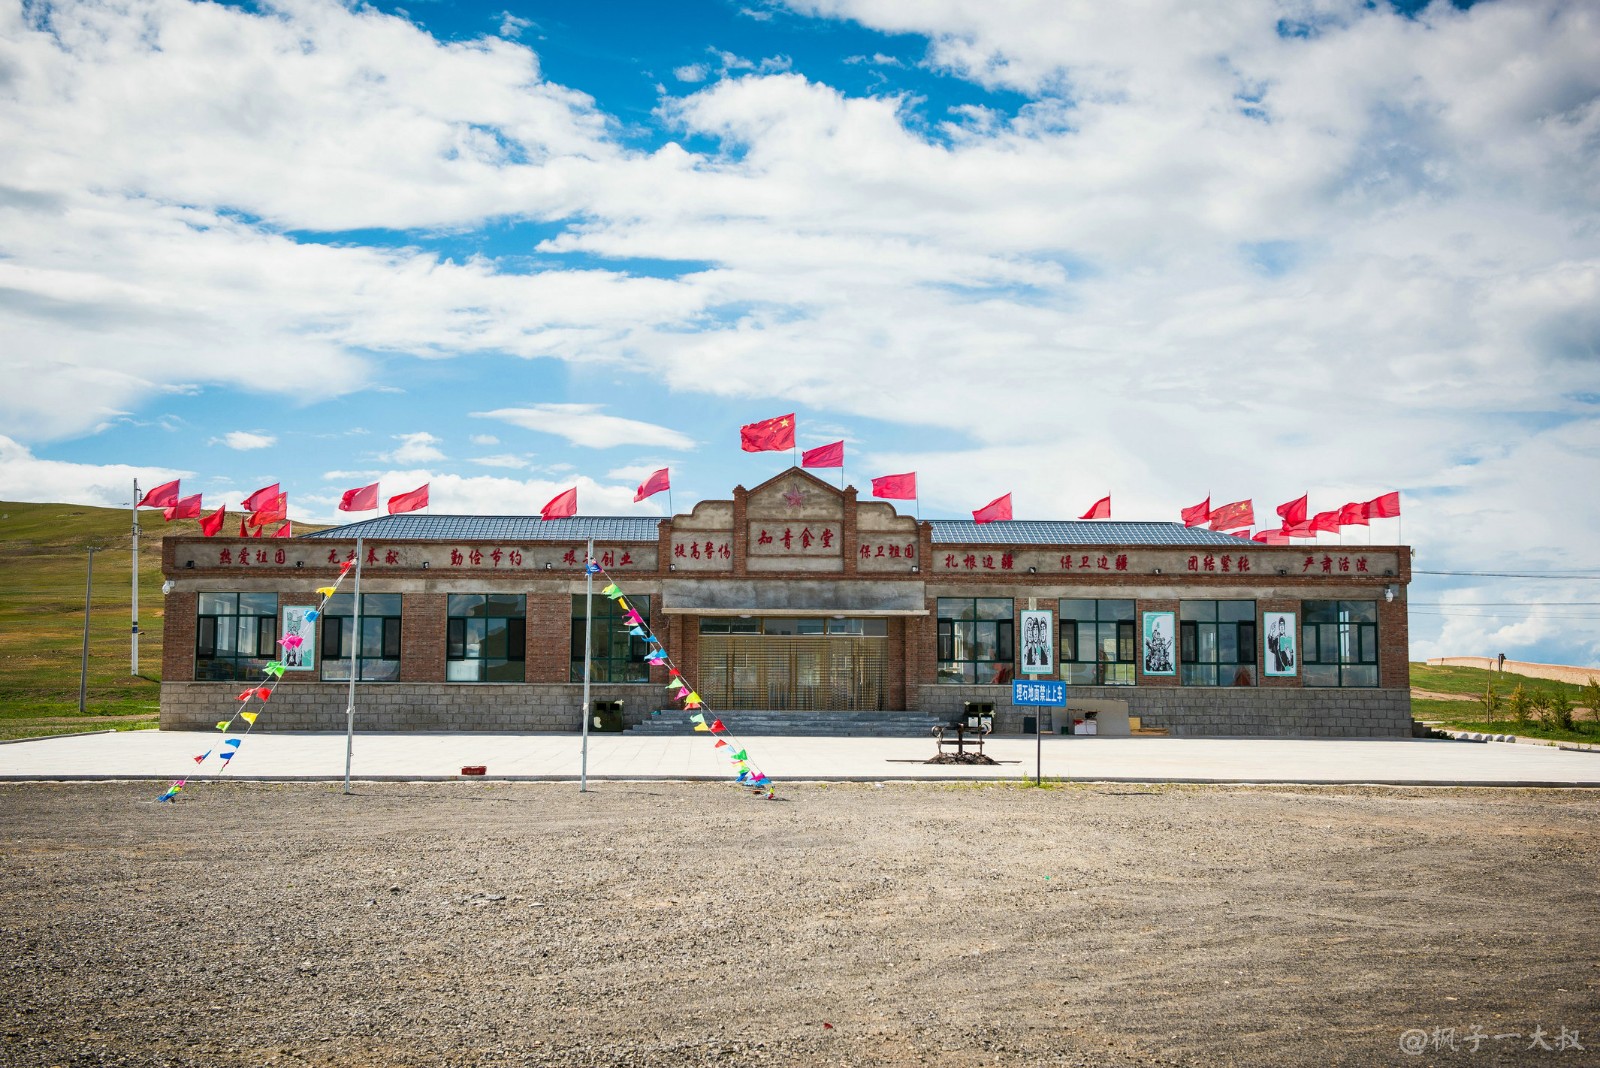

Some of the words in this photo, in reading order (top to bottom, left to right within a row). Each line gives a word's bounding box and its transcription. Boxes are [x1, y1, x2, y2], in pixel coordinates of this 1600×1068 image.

[758, 527, 834, 549] 知青食堂
[219, 547, 286, 566] 热爱祖国
[450, 547, 522, 567] 勤俭节约
[563, 549, 633, 567] 艰创业
[674, 541, 731, 560] 提高警惕
[860, 544, 915, 559] 保卫祖国
[945, 553, 1015, 570] 扎根边疆
[1060, 554, 1129, 571] 保卫边疆
[1187, 554, 1251, 573] 团结紧张
[1302, 554, 1369, 574] 严肃活泼
[1016, 683, 1063, 702] 理石地面禁止上车
